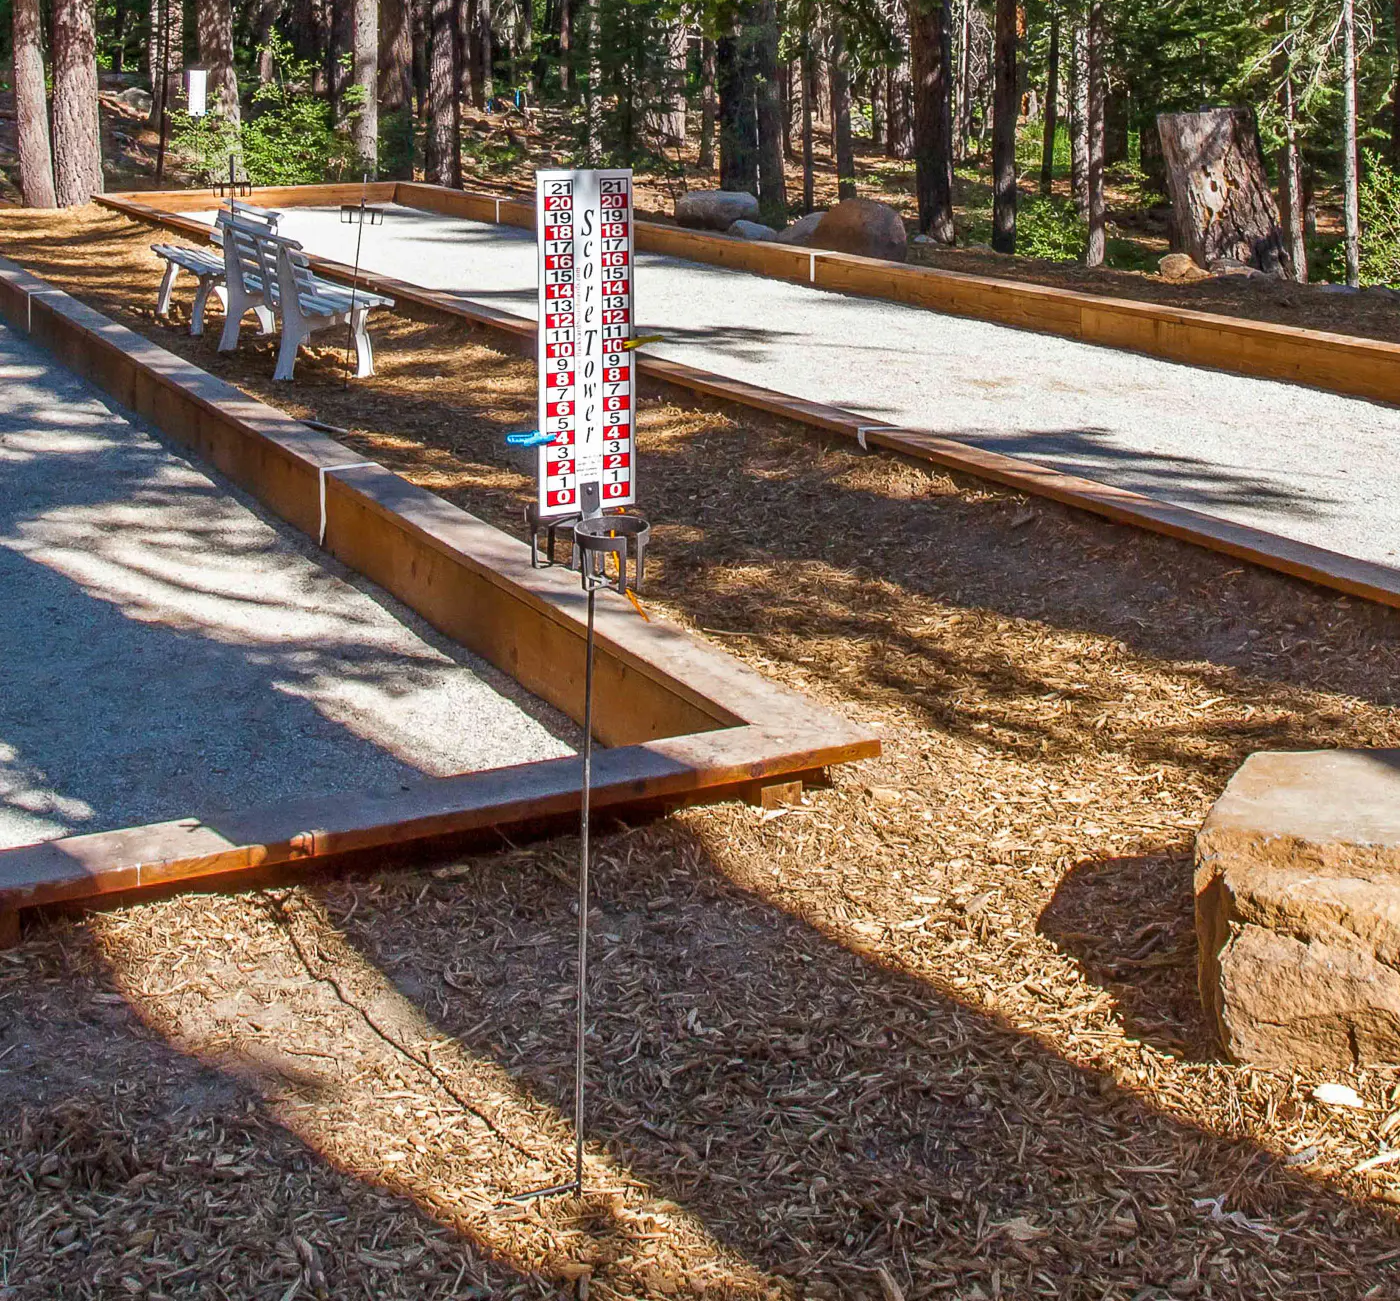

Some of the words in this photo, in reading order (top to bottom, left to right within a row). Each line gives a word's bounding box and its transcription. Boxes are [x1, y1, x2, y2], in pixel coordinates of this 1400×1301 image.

[552, 182, 570, 194] 21
[602, 181, 622, 193] 21
[550, 197, 572, 210] 20
[602, 195, 622, 208] 20
[550, 212, 572, 224] 19
[602, 210, 622, 222] 19
[550, 226, 572, 239] 18
[602, 224, 624, 236] 18
[550, 242, 572, 253] 17
[603, 239, 624, 250] 17
[550, 256, 572, 268] 16
[602, 252, 624, 266] 16
[551, 270, 572, 282] 15
[604, 267, 624, 280] 15
[550, 284, 572, 298] 14
[602, 282, 624, 294] 14
[551, 300, 572, 312] 13
[604, 296, 624, 308] 13
[550, 314, 573, 327] 12
[603, 310, 624, 323] 12
[552, 330, 570, 342] 11
[604, 325, 622, 337] 11
[551, 344, 572, 356] 10
[603, 340, 622, 352] 10
[557, 358, 568, 370] 9
[608, 354, 620, 366] 9
[556, 372, 569, 386] 8
[608, 368, 620, 381] 8
[556, 388, 568, 400] 7
[609, 384, 620, 395] 7
[556, 402, 570, 415] 6
[608, 397, 620, 410] 6
[558, 418, 568, 429] 5
[610, 412, 620, 424] 5
[556, 432, 569, 444] 4
[608, 426, 620, 438] 4
[558, 447, 568, 458] 3
[610, 441, 620, 452] 3
[558, 461, 570, 474] 2
[609, 455, 622, 468] 2
[560, 476, 566, 488] 1
[611, 470, 618, 482] 1
[610, 484, 622, 496] 0
[557, 490, 570, 504] 0
